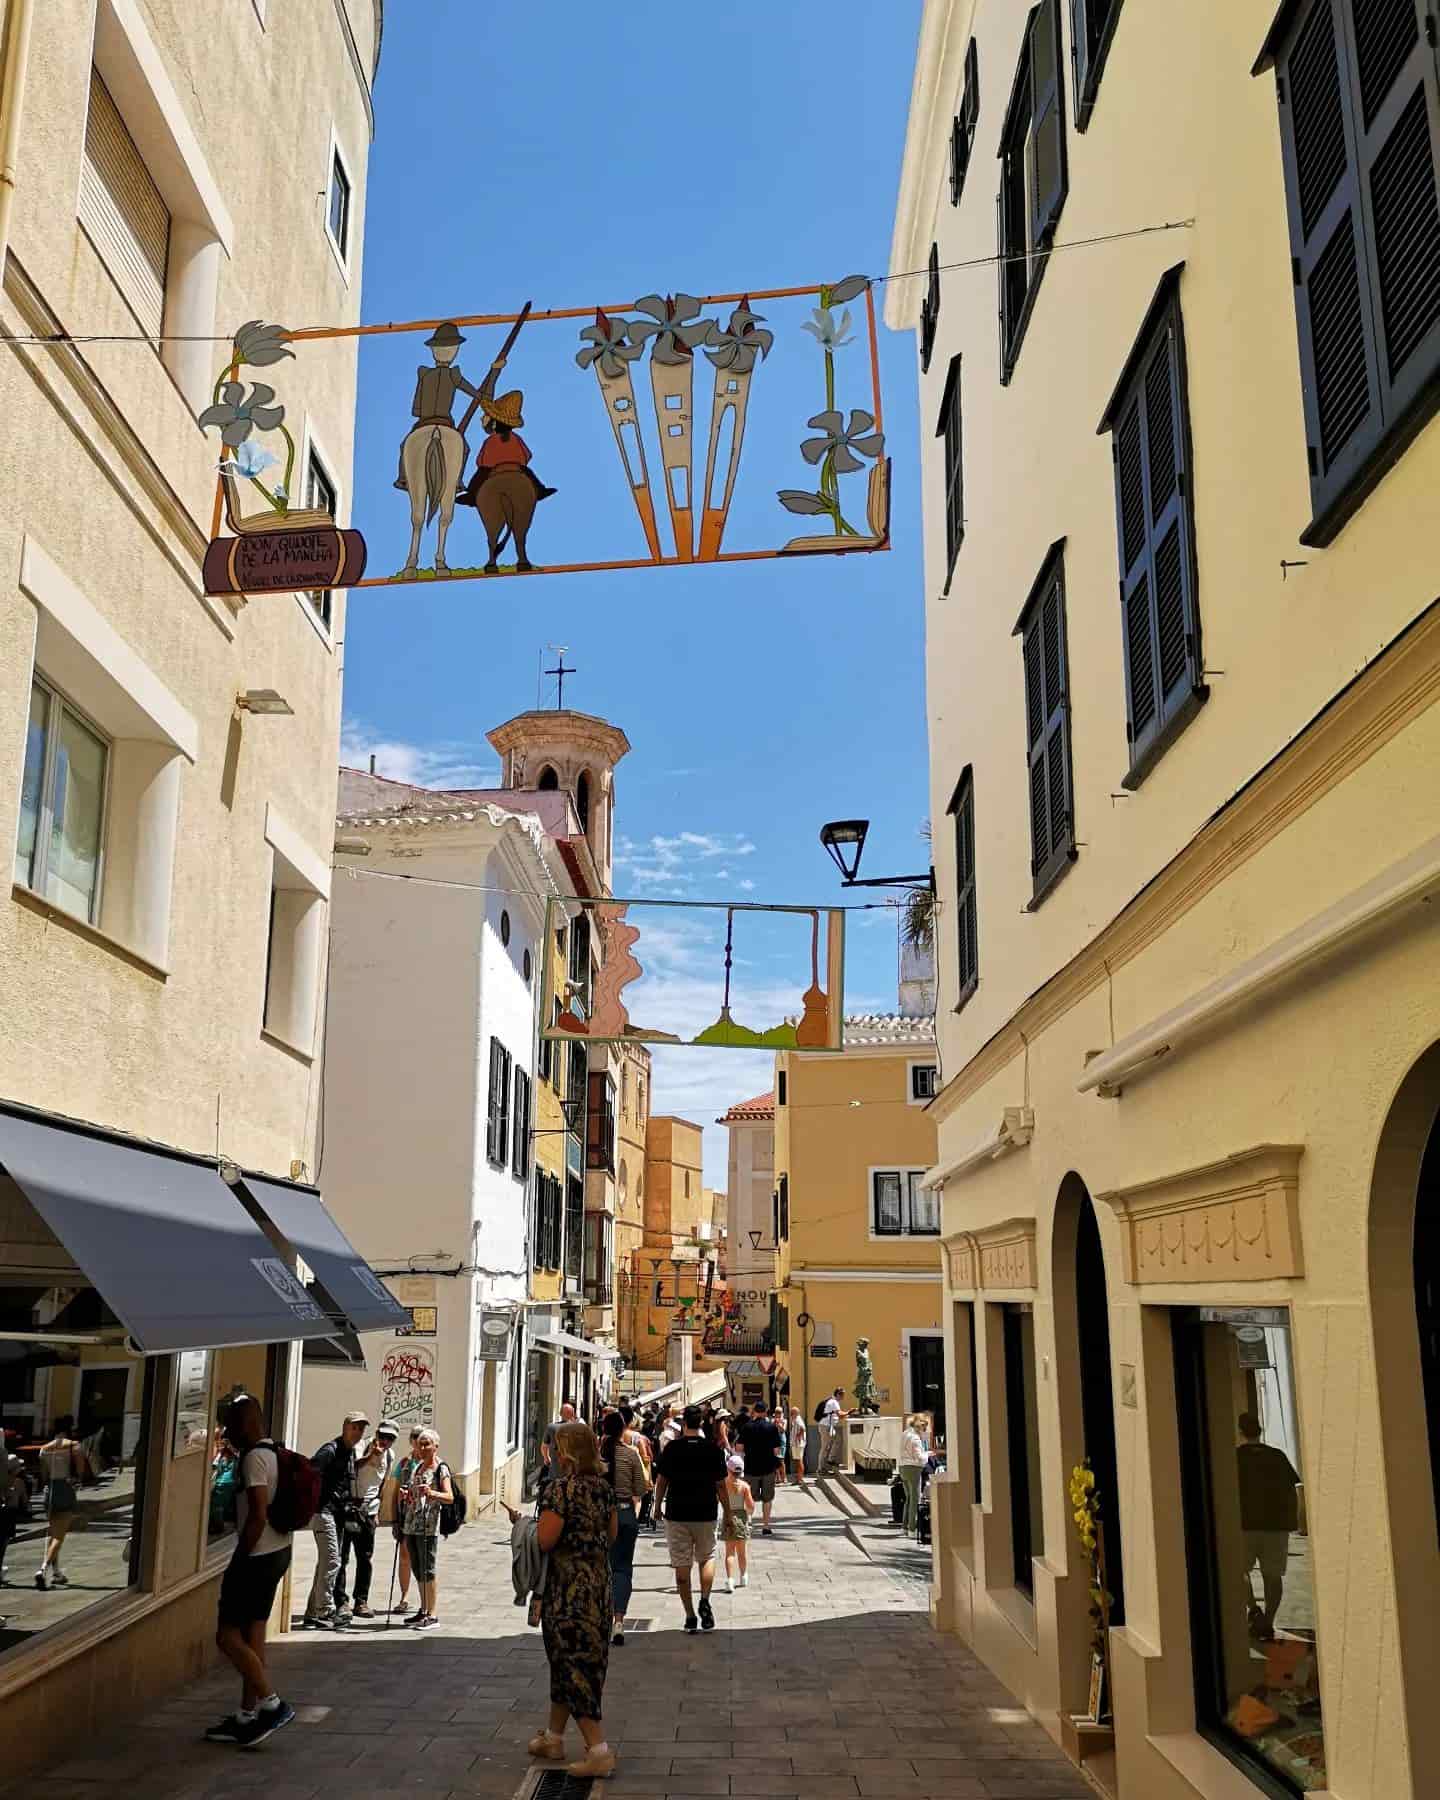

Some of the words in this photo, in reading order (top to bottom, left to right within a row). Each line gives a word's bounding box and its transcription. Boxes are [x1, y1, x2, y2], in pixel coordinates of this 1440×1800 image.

[242, 537, 271, 552] DON
[279, 535, 328, 552] QUIJOTE
[242, 553, 256, 568] DE
[263, 550, 280, 565] LA
[284, 548, 333, 566] MANCHA
[736, 1290, 767, 1301] NOU
